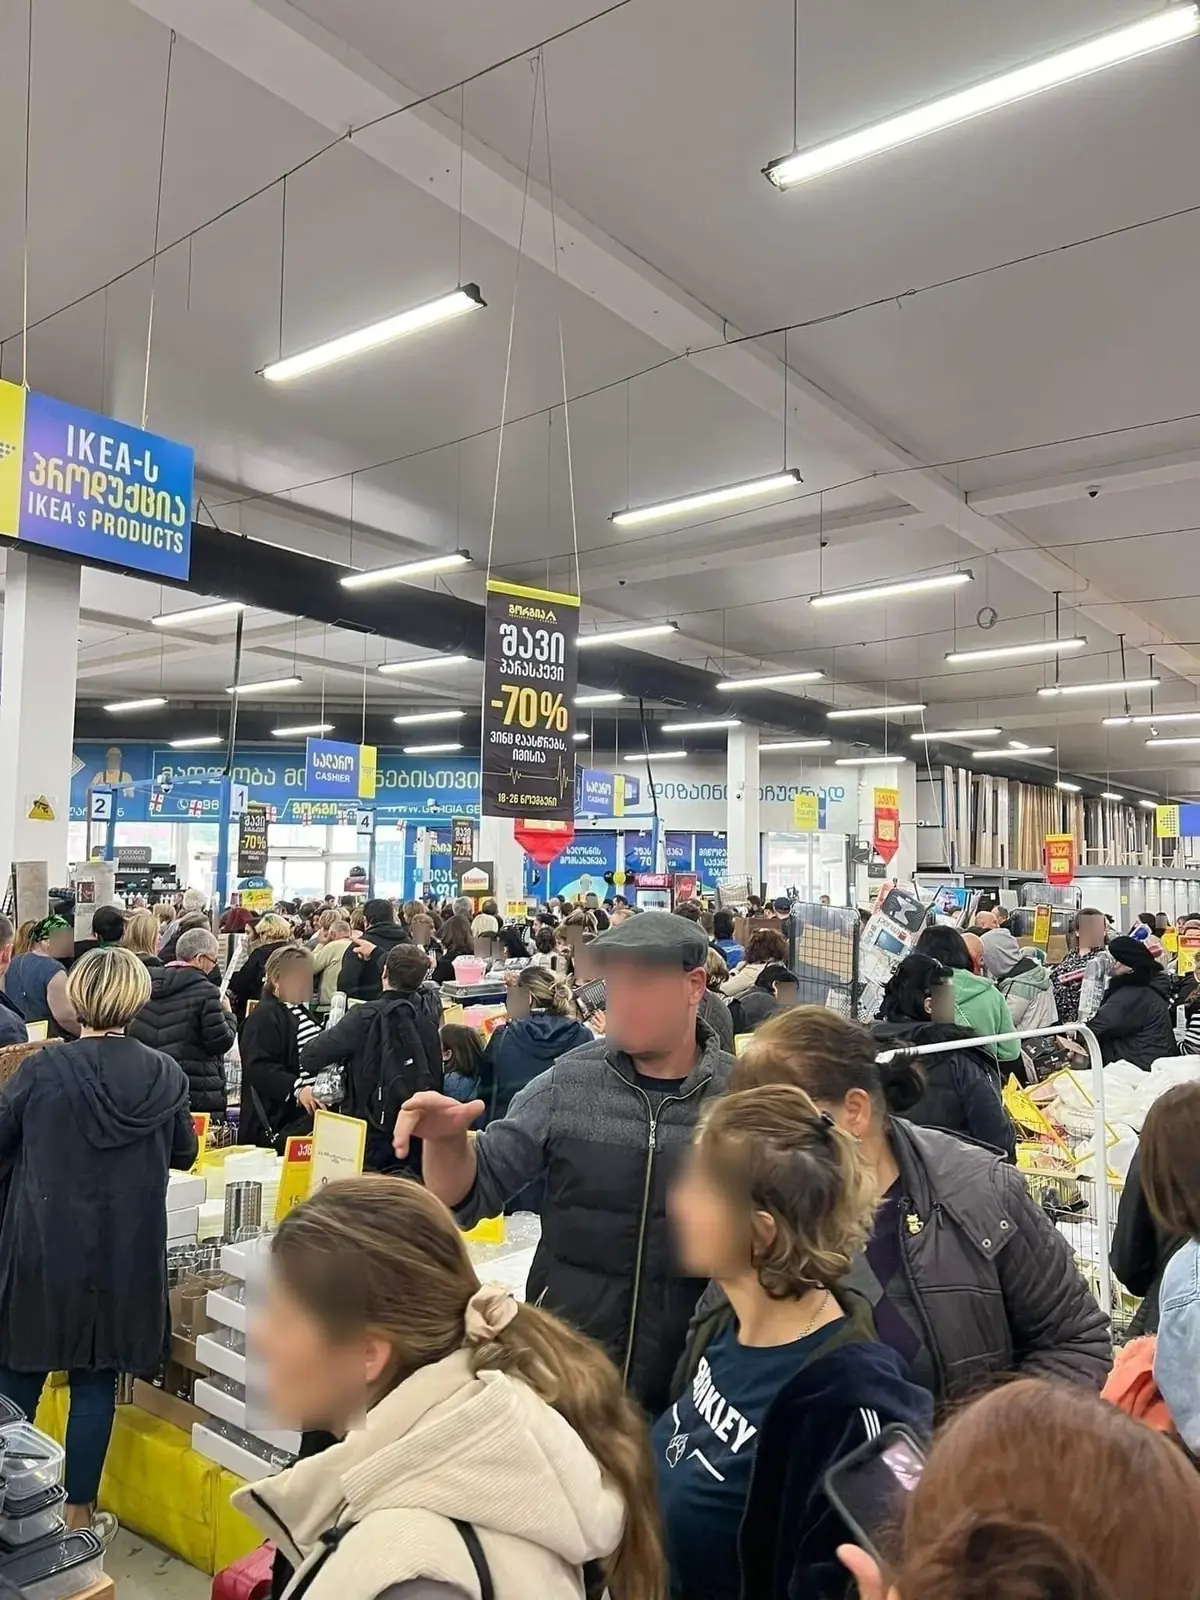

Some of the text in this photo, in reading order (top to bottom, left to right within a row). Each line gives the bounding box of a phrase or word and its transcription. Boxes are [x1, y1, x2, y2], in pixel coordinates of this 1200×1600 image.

[28, 451, 186, 527] პროდუქცია
[92, 508, 184, 554] PRODUCTS
[499, 623, 565, 664] შავი
[500, 658, 564, 682] პარასკევი
[491, 684, 568, 732] -70%
[490, 730, 514, 745] ვინც
[512, 748, 546, 764] იმისია
[315, 772, 350, 784] CASHIER
[238, 790, 244, 804] 1
[94, 798, 106, 813] 2
[360, 815, 370, 828] 4
[240, 835, 266, 849] -70%
